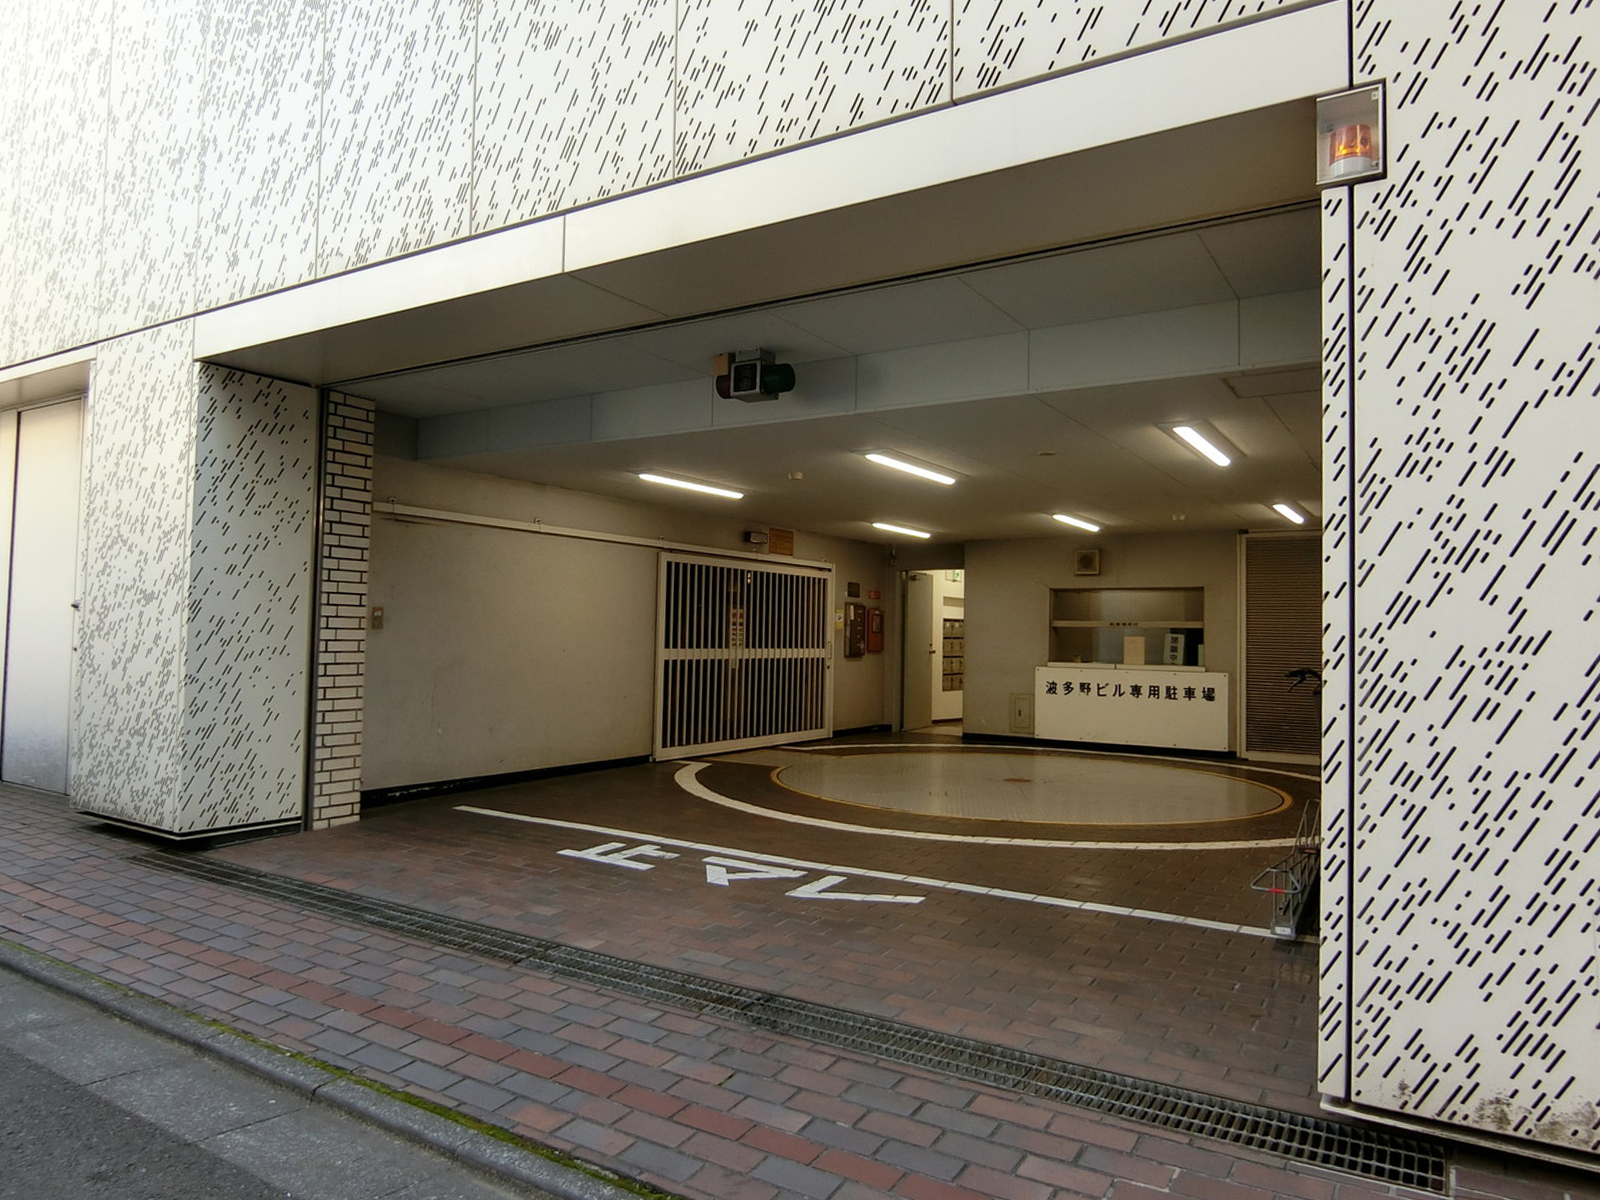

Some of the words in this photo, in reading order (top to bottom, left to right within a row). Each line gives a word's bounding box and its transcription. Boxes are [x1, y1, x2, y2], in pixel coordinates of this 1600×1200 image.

[1045, 680, 1216, 702] 波多野ビル専用駐車場
[556, 841, 926, 904] 止マレ
